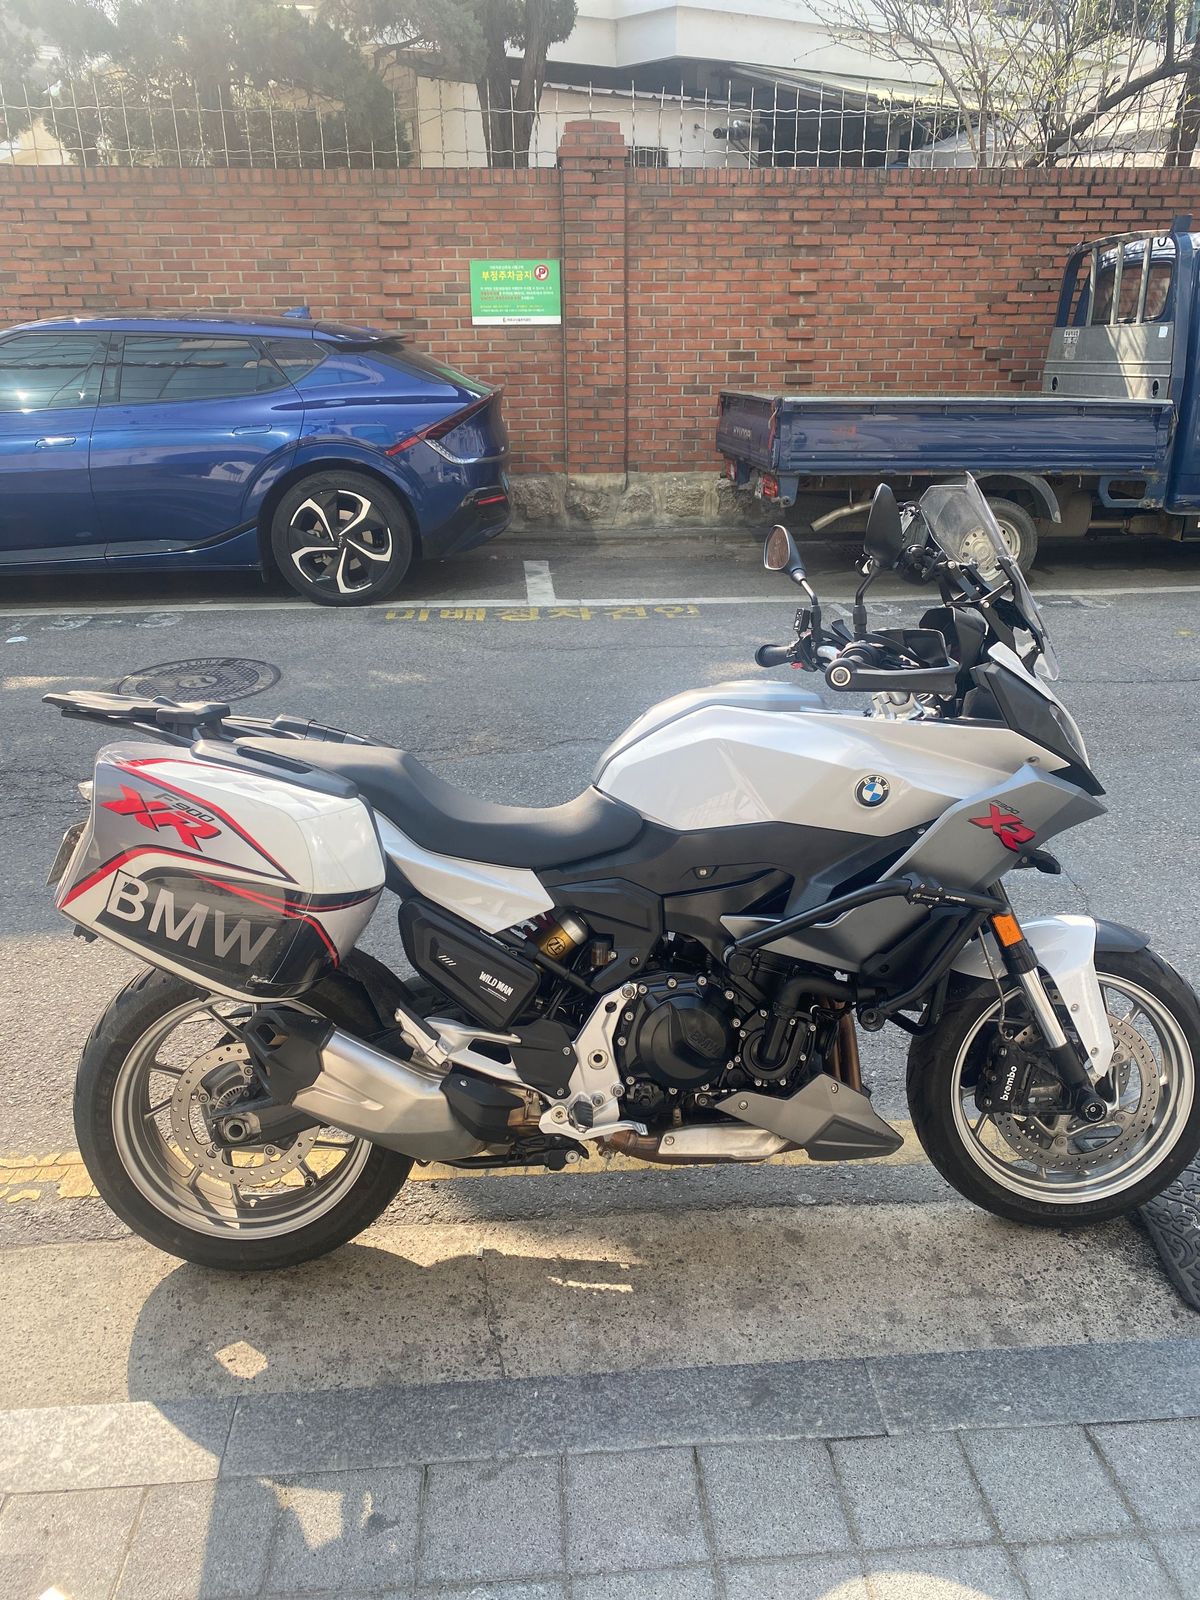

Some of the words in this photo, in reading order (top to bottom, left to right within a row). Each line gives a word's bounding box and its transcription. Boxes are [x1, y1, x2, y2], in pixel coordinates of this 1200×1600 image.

[482, 270, 532, 281] 부정주차금지
[863, 776, 890, 791] BMW
[100, 783, 222, 852] XR
[968, 803, 1036, 852] XR
[106, 871, 278, 965] BMW
[479, 971, 498, 987] WILD
[495, 980, 514, 997] MAN
[1000, 1065, 1018, 1101] brembo
